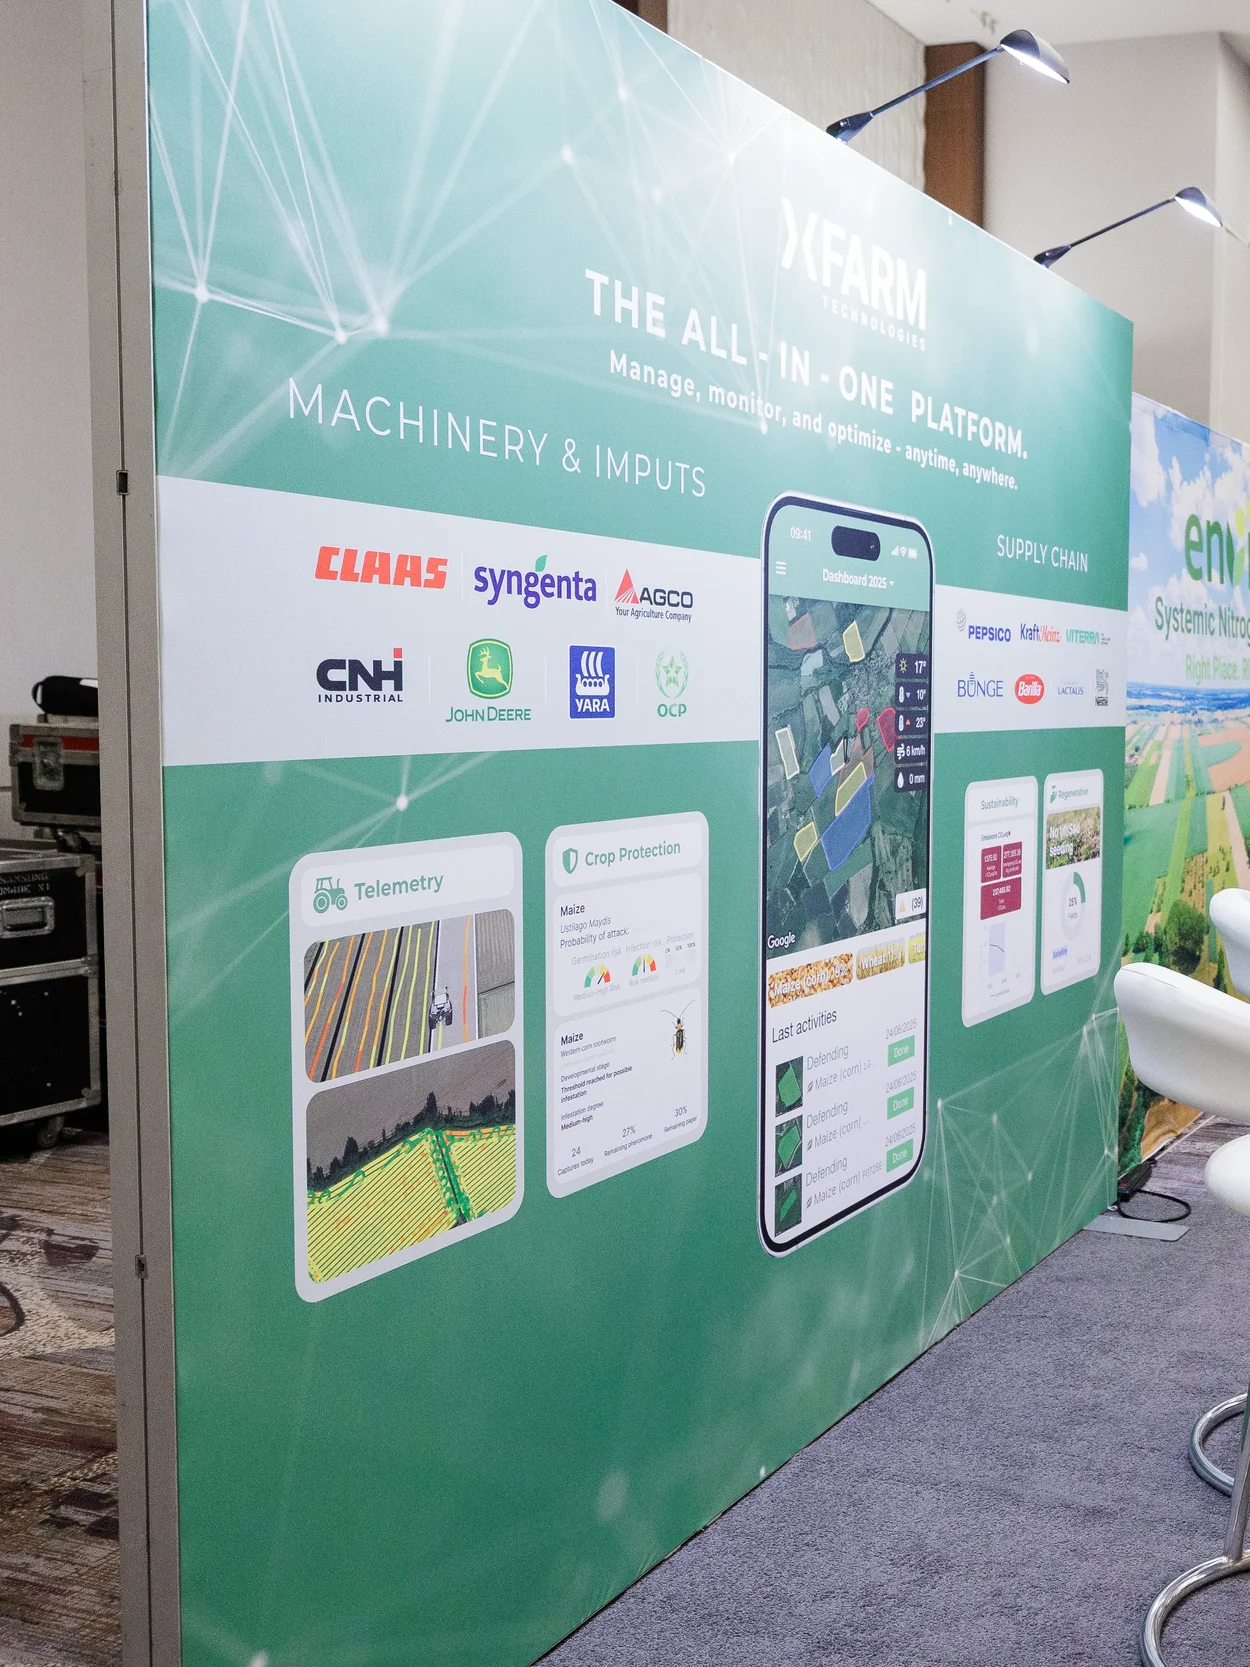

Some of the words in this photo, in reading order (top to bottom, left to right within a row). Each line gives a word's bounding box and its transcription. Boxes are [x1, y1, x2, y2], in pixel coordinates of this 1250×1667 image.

[781, 197, 926, 331] XFARM
[822, 294, 926, 352] TECHNOLOGIES
[585, 268, 666, 339] THE
[681, 308, 747, 366] ALL
[780, 341, 810, 387] IN
[838, 364, 894, 415] ONE
[911, 389, 1028, 460] PLATFORM.
[609, 349, 700, 402] Manage,
[708, 383, 787, 430] monitor,
[792, 406, 822, 434] and
[827, 422, 892, 454] optimize
[905, 443, 959, 477] anytime,
[962, 464, 1018, 491] anywhere.
[289, 377, 549, 466] MACHINERY
[562, 438, 582, 474] &
[595, 444, 706, 497] IMPUTS
[790, 527, 811, 541] 09:41
[997, 534, 1047, 564] SUPPLY
[1051, 546, 1088, 572] CHAIN
[315, 546, 448, 589] CLAAS
[474, 565, 597, 609] syngenta
[822, 568, 867, 586] Dashboard
[868, 575, 887, 589] 2025
[639, 587, 693, 609] AGCO
[615, 606, 629, 617] Your
[630, 608, 664, 620] Agriculture
[665, 610, 692, 623] Company
[1155, 596, 1215, 641] Systemic
[968, 625, 1011, 642] PEPSICO
[1065, 628, 1100, 645] VITERRA
[1185, 654, 1211, 686] Right
[1213, 656, 1240, 681] Place.
[318, 694, 403, 703] INDUSTRIAL
[575, 698, 610, 712] YARA
[445, 706, 487, 723] JOHN
[487, 705, 531, 722] DEERE
[657, 703, 687, 718] OCP
[980, 794, 1020, 810] Sustainability
[1058, 787, 1088, 800] Regenerative
[585, 850, 615, 867] Crop
[619, 840, 681, 861] Protection
[354, 873, 444, 901] Telemetry
[560, 903, 586, 917] Maize
[560, 920, 588, 934] Ustilago
[589, 916, 611, 929] Maydis
[560, 934, 596, 949] Probability
[598, 931, 606, 940] of
[607, 927, 630, 939] attack:
[625, 941, 655, 954] Infection
[655, 939, 663, 949] risk
[666, 932, 694, 944] Protection
[768, 932, 795, 948] Google
[572, 949, 610, 965] Germination
[610, 948, 622, 957] risk
[860, 954, 885, 969] Wheat
[675, 967, 686, 976] Low
[573, 984, 609, 1002] Medium-High
[609, 983, 620, 992] Risk
[628, 979, 639, 988] Risk
[774, 980, 800, 997] Maize
[803, 969, 829, 992] (corn)
[772, 1022, 794, 1044] Last
[796, 1009, 837, 1037] activities
[560, 1046, 581, 1058] Western
[581, 1043, 593, 1052] corn
[593, 1036, 617, 1048] rootworm
[561, 1032, 584, 1046] Maize
[806, 1045, 849, 1070] Defending
[893, 1045, 909, 1058] Done
[561, 1065, 596, 1083] Developmental
[596, 1061, 611, 1071] stage:
[561, 1080, 586, 1094] Threshold
[586, 1073, 606, 1086] reached
[606, 1071, 614, 1079] for
[613, 1065, 633, 1078] possible
[814, 1072, 838, 1091] Maize
[839, 1060, 862, 1082] (corn)
[560, 1089, 587, 1104] infestation
[587, 1101, 604, 1112] degree:
[674, 1105, 687, 1117] 30%
[806, 1101, 848, 1129] Defending
[893, 1097, 908, 1111] Done
[561, 1114, 593, 1131] Medium-high
[622, 1125, 636, 1138] 27%
[664, 1121, 685, 1133] Remaining
[685, 1115, 697, 1126] paper
[814, 1129, 837, 1149] Maize
[839, 1116, 861, 1138] (corn)
[571, 1146, 581, 1158] 24
[603, 1142, 628, 1158] Remaining
[627, 1132, 653, 1152] pheromone
[557, 1162, 580, 1176] Captures
[580, 1156, 594, 1168] today
[805, 1157, 848, 1187] Defending
[892, 1149, 908, 1164] Done
[813, 1186, 837, 1206] Maize
[838, 1170, 861, 1194] (corn)
